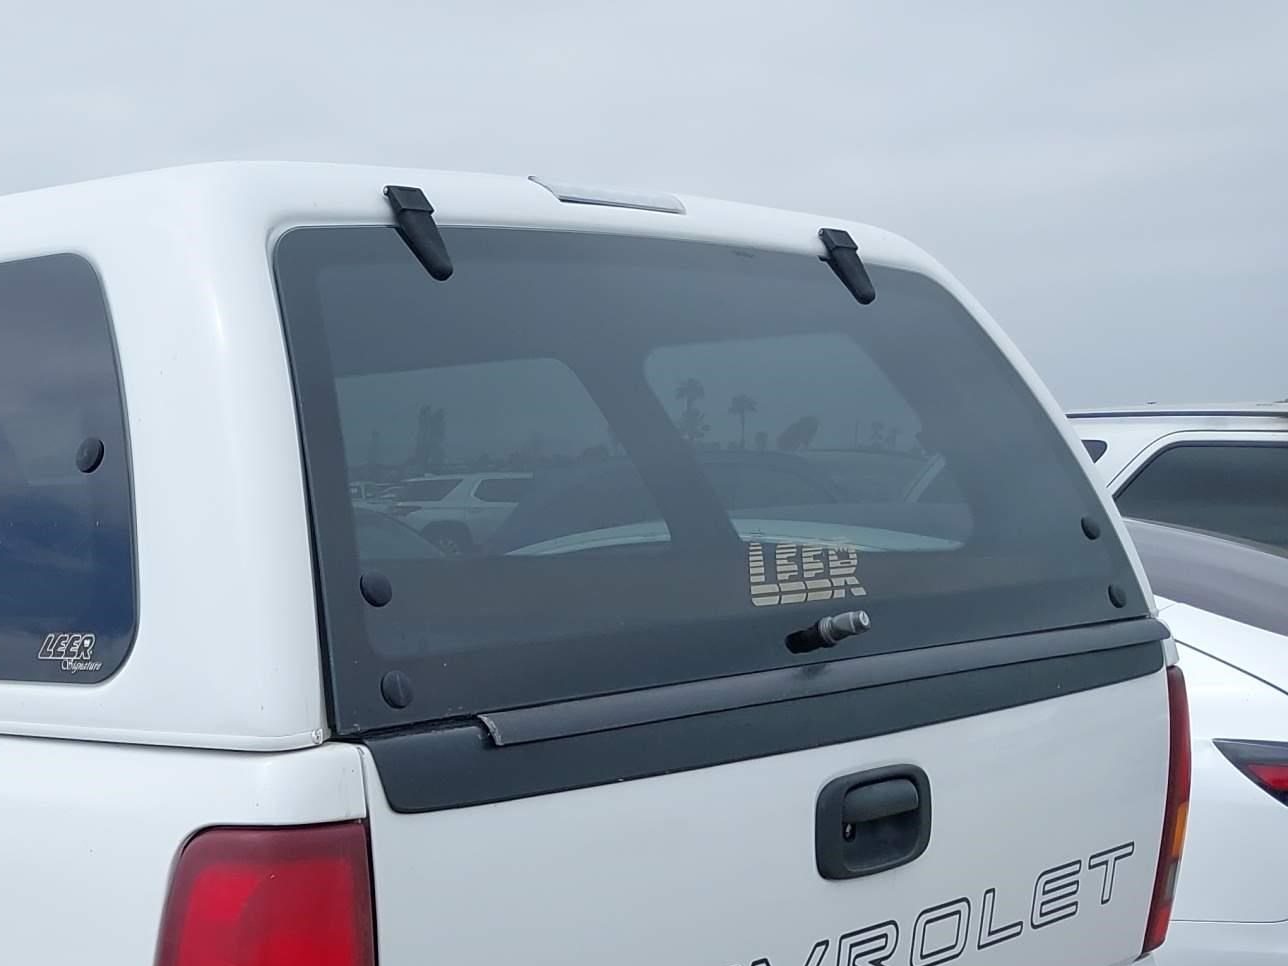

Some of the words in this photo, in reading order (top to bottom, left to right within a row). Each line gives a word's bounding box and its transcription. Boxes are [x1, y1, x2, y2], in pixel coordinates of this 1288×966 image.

[748, 542, 868, 607] LEER
[37, 633, 96, 659] LEER
[60, 658, 102, 673] Signature
